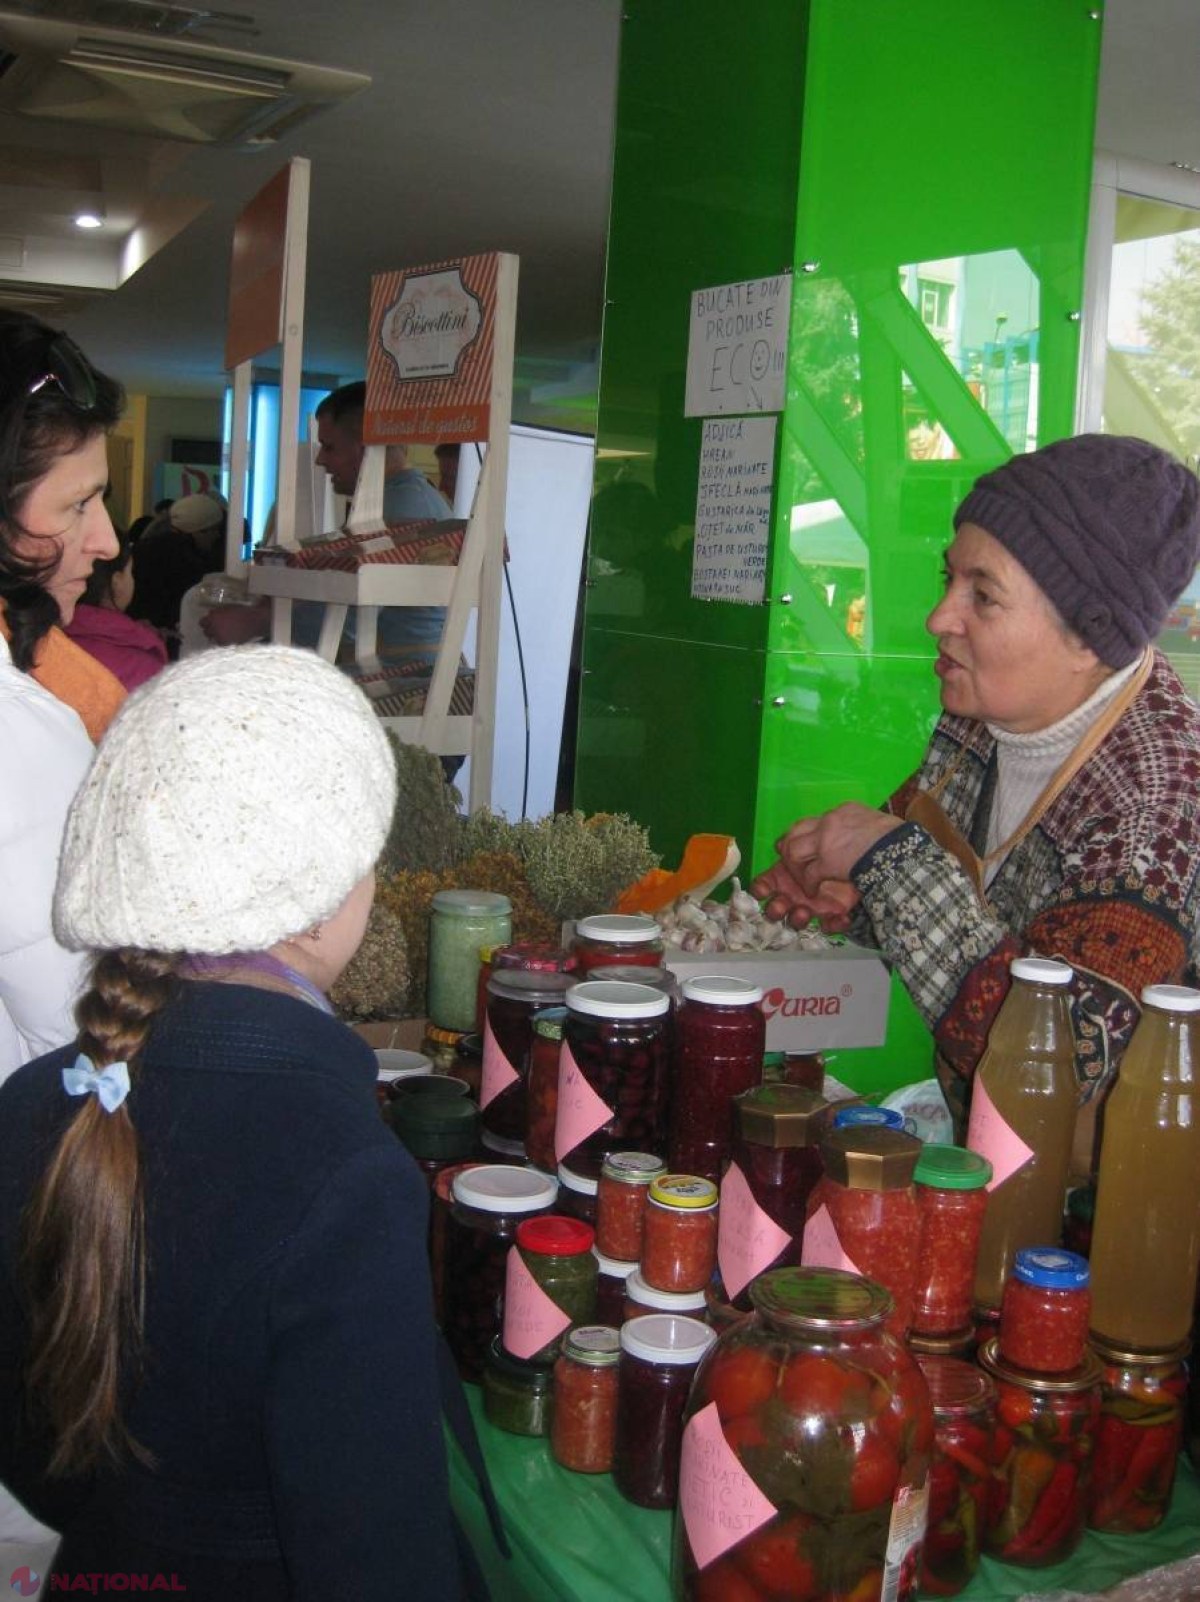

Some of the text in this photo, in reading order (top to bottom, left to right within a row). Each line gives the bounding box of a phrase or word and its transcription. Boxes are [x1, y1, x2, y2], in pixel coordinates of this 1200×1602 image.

[697, 282, 756, 318] BUCATE
[391, 302, 469, 339] Biscottini
[706, 307, 774, 341] PRODUSE
